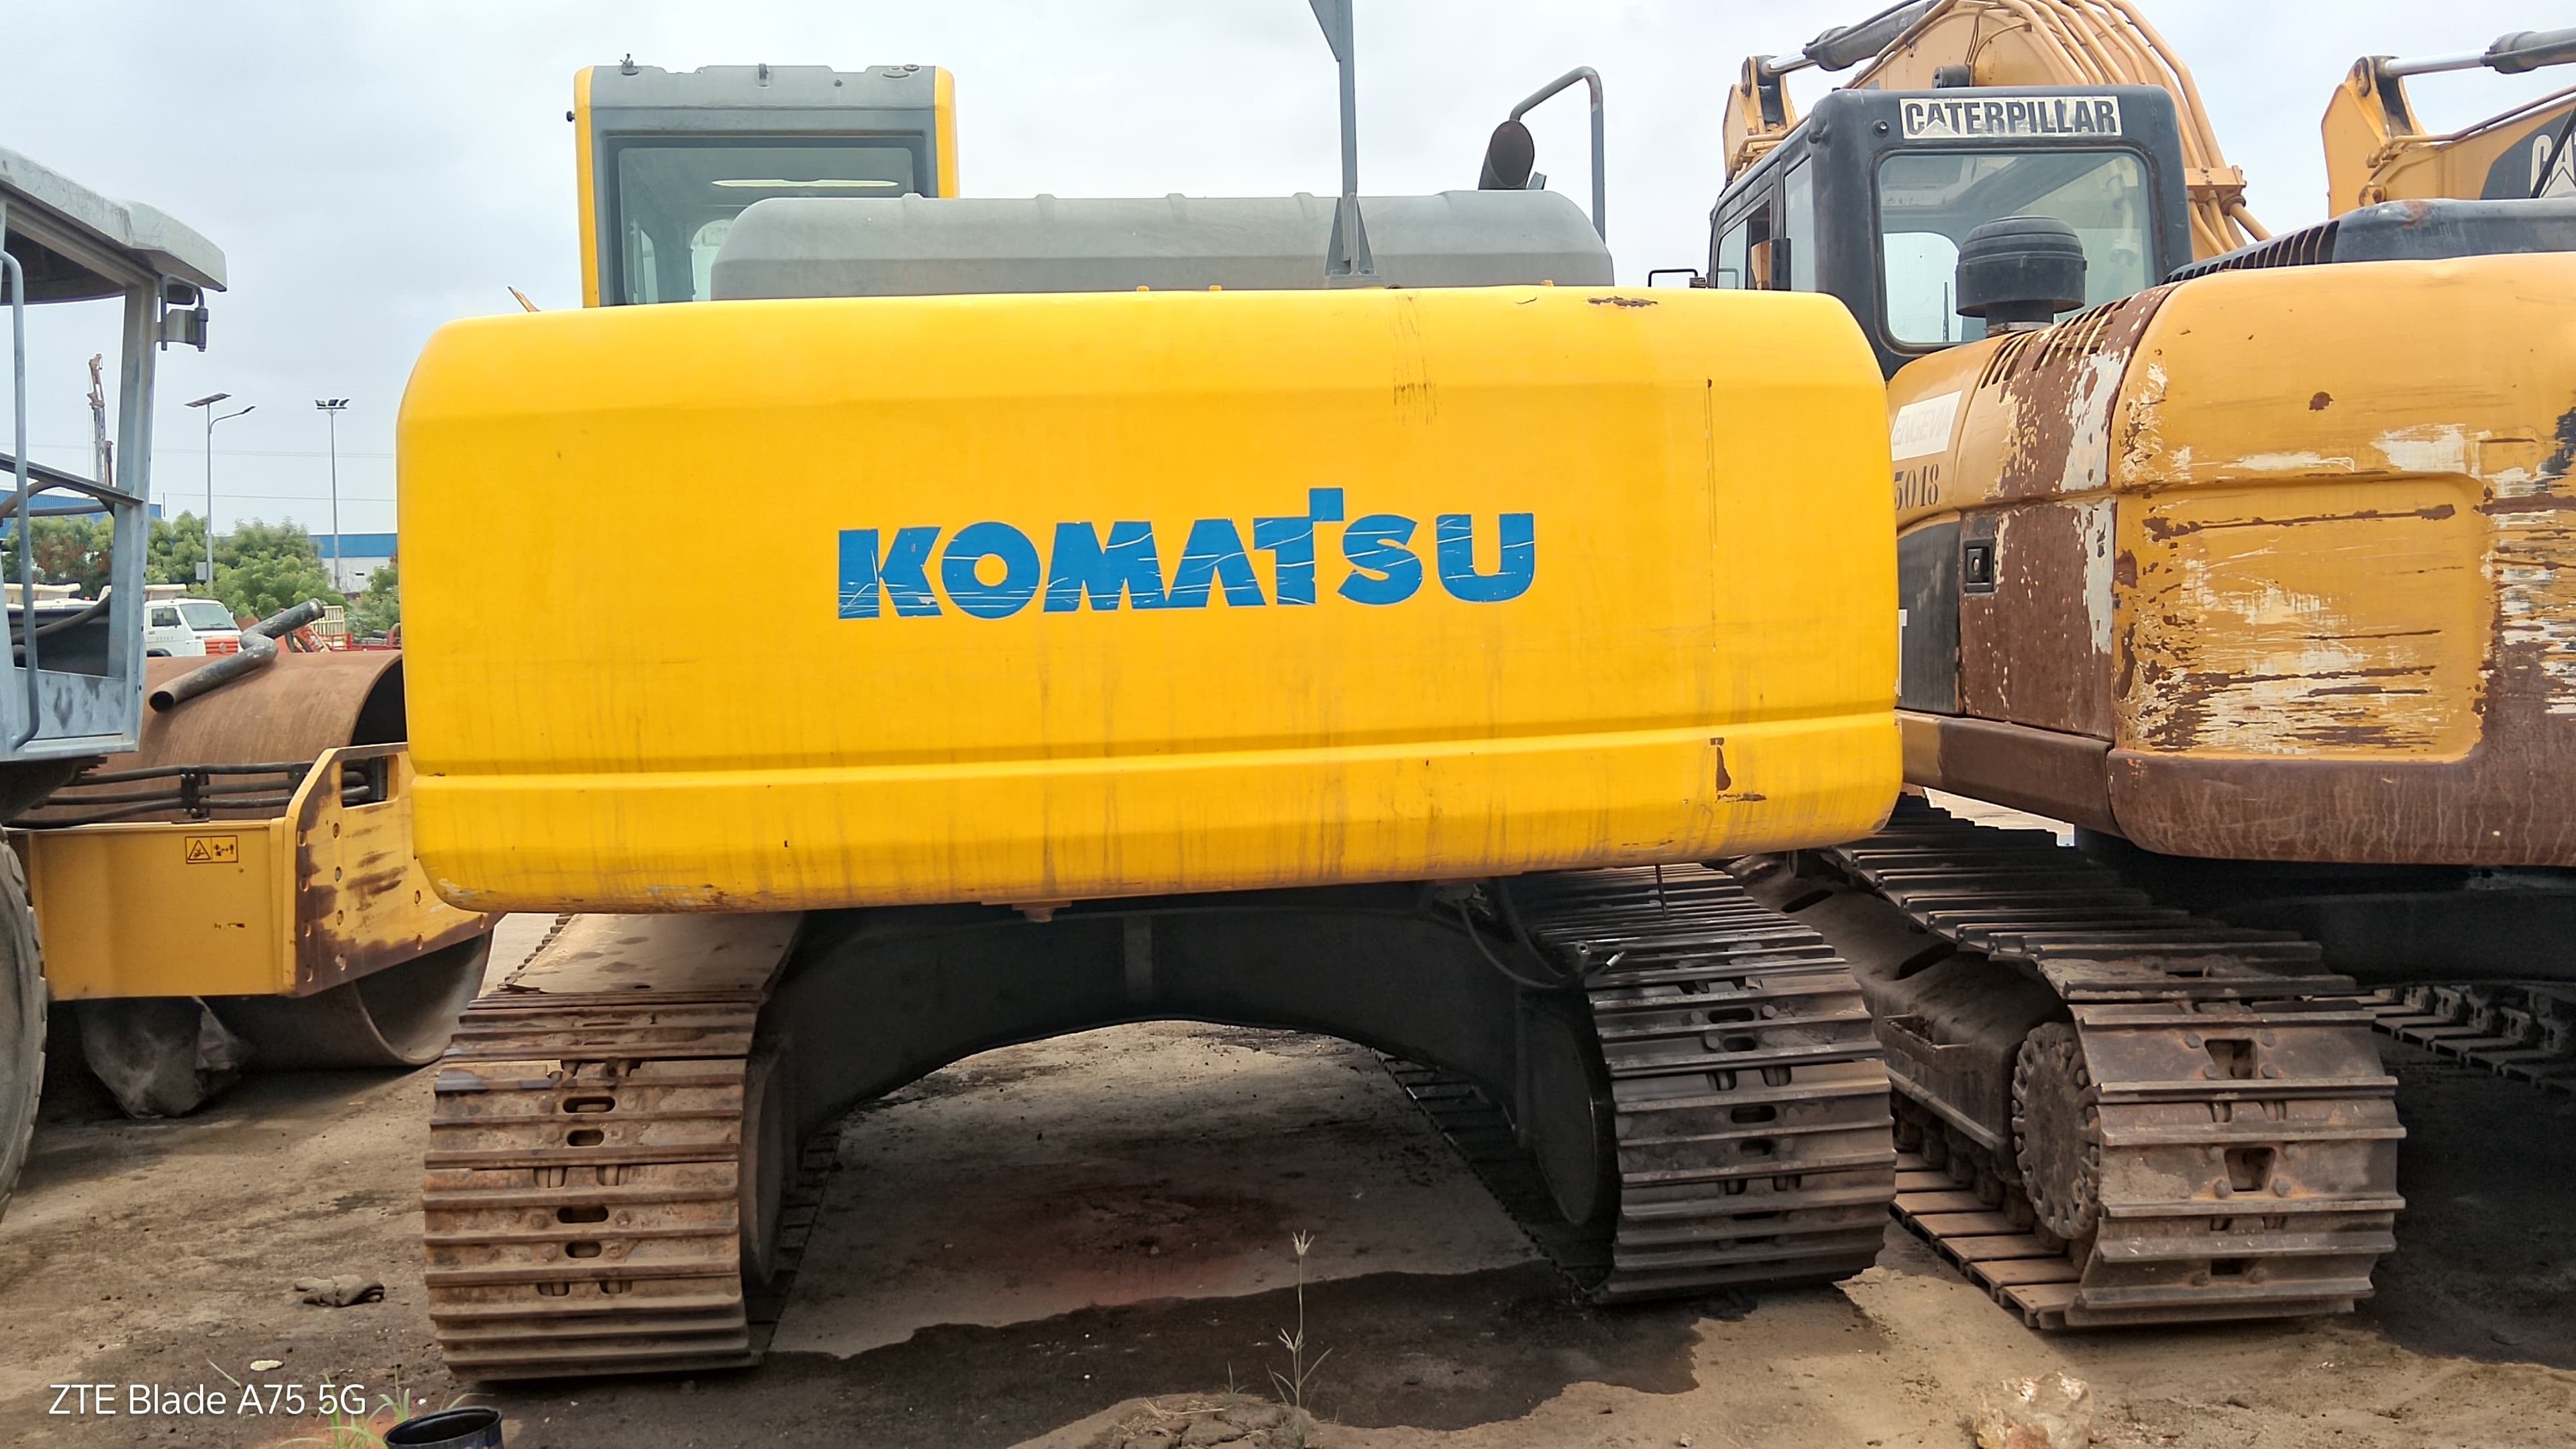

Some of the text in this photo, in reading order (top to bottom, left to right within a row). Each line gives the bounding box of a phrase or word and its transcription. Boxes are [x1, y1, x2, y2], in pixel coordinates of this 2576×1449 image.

[1905, 101, 2117, 135] CATERPILLAR
[2530, 131, 2576, 199] CA
[1894, 464, 1939, 511] 5018
[838, 488, 1536, 620] KOMATSU
